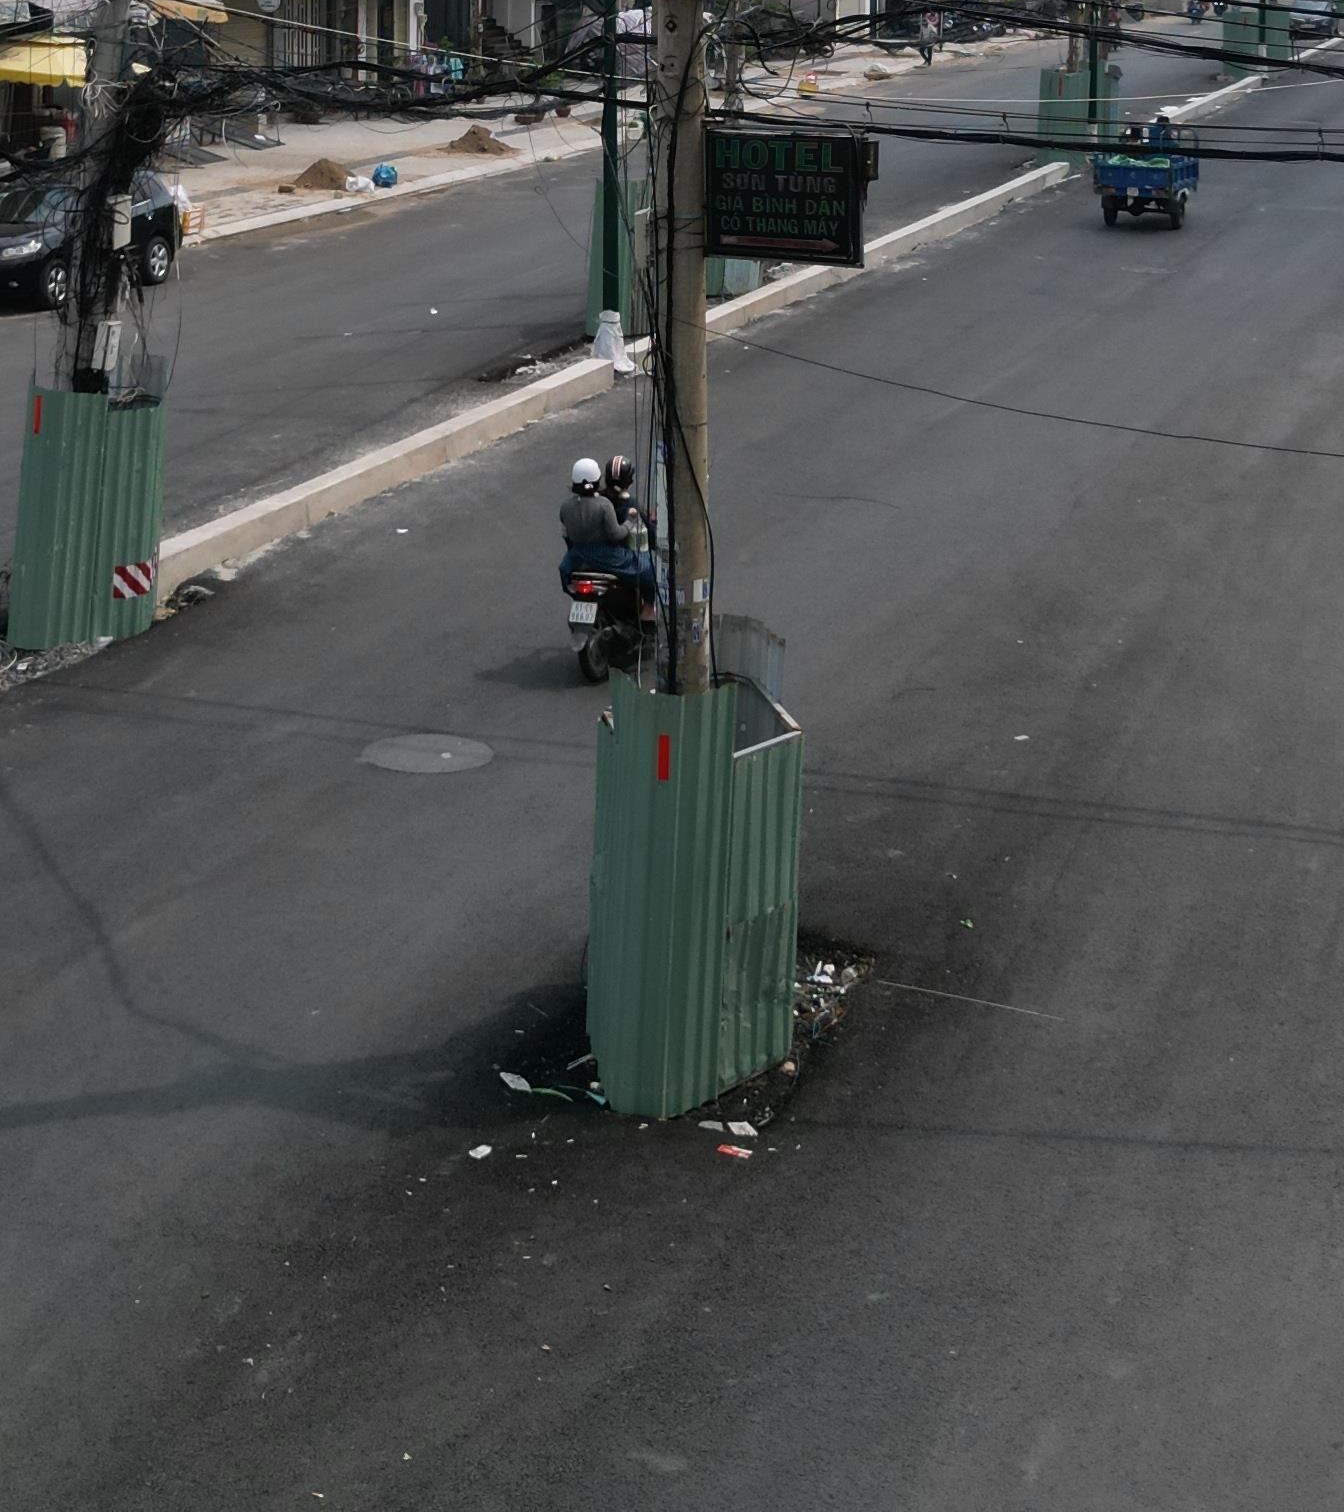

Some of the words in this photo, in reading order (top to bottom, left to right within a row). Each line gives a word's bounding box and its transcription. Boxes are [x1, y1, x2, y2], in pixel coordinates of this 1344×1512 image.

[715, 139, 843, 173] HOTEL
[722, 171, 766, 192] SƠN
[774, 171, 837, 194] TÙNG
[752, 193, 797, 215] BÌNH
[805, 195, 846, 216] DÂN
[720, 212, 740, 231] CÓ
[746, 217, 798, 234] THANG
[804, 216, 841, 237] MÁY
